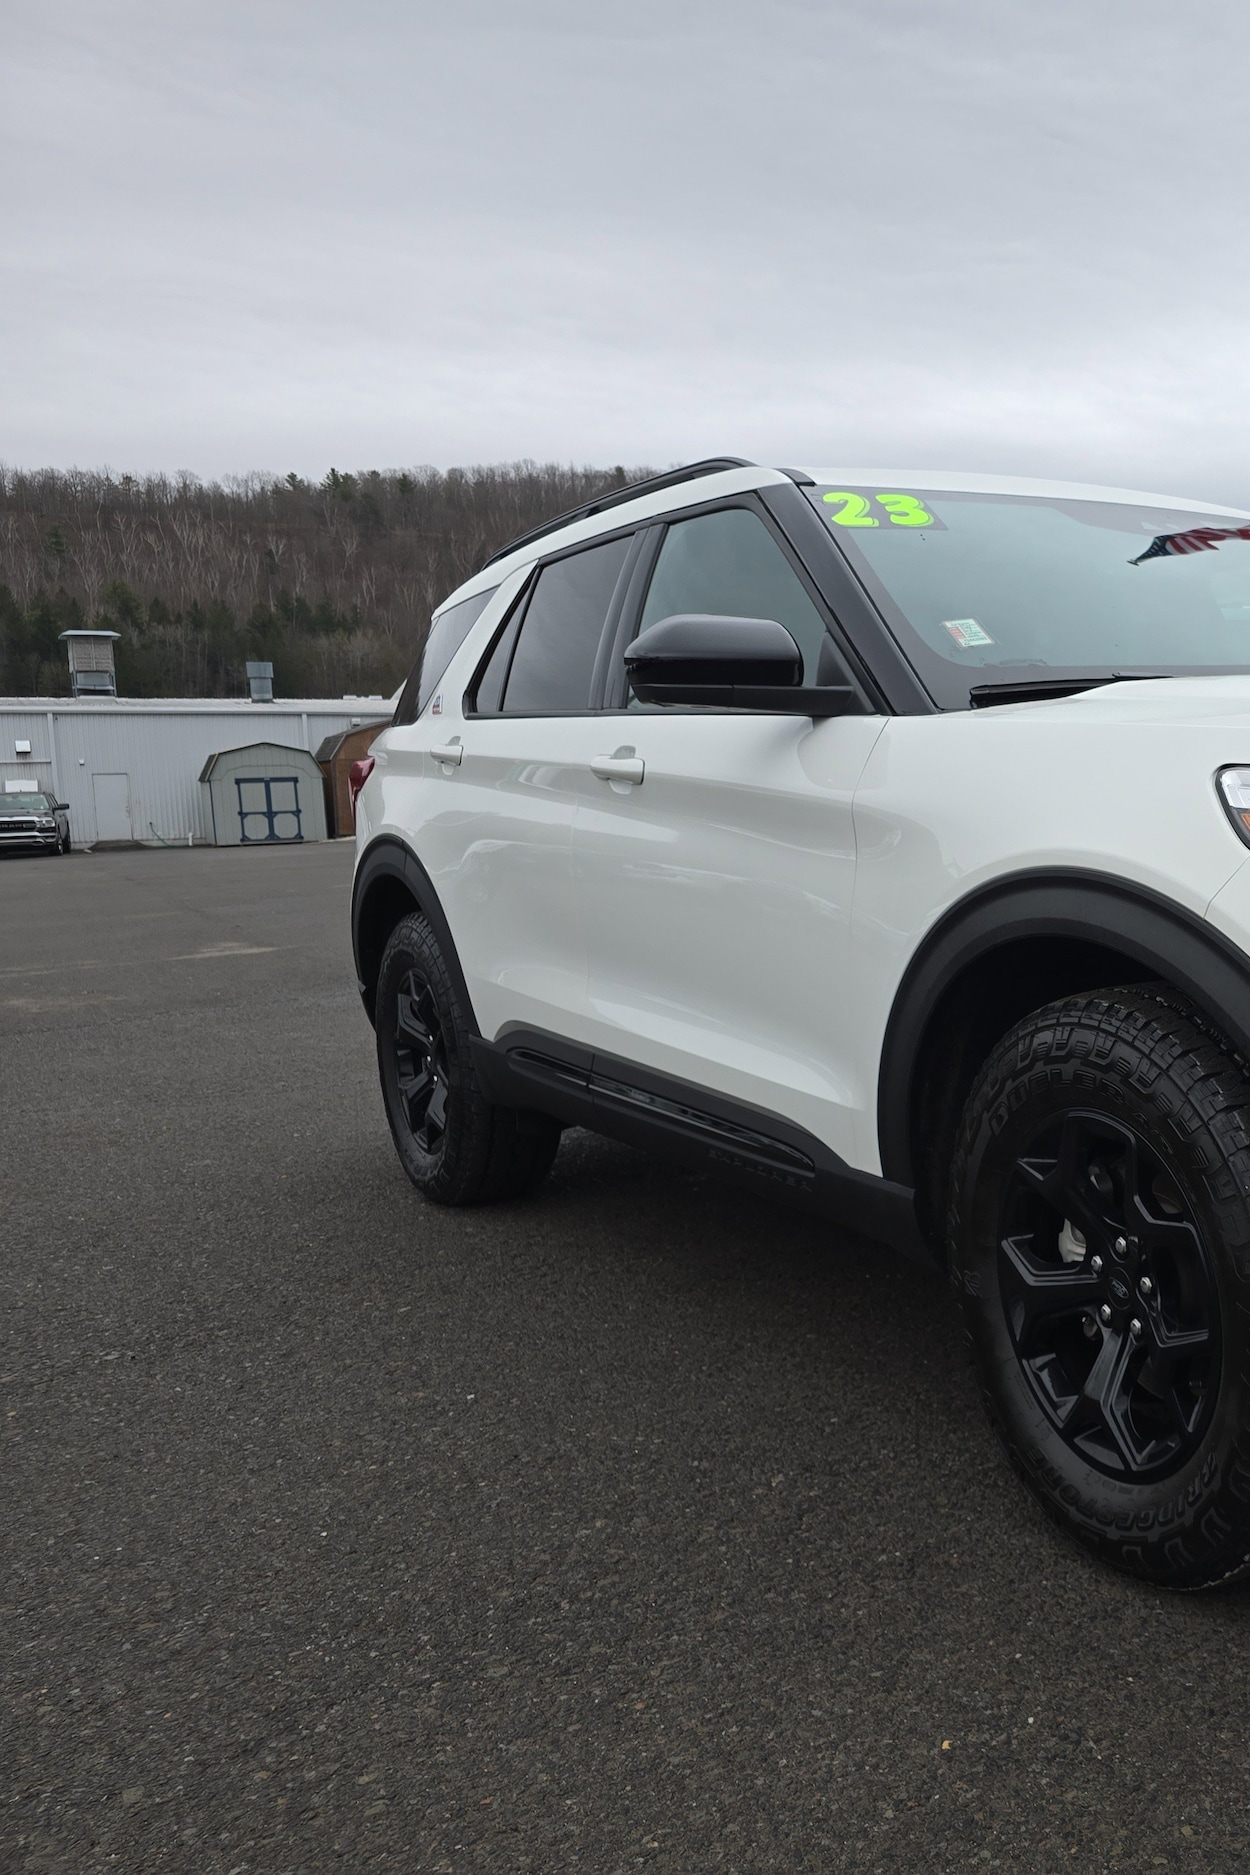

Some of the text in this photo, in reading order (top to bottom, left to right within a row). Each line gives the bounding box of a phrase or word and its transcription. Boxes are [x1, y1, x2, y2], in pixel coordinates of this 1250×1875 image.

[822, 491, 935, 527] 23
[987, 1067, 1126, 1137] DUELER
[1025, 1446, 1220, 1533] BRIDGESTONE
